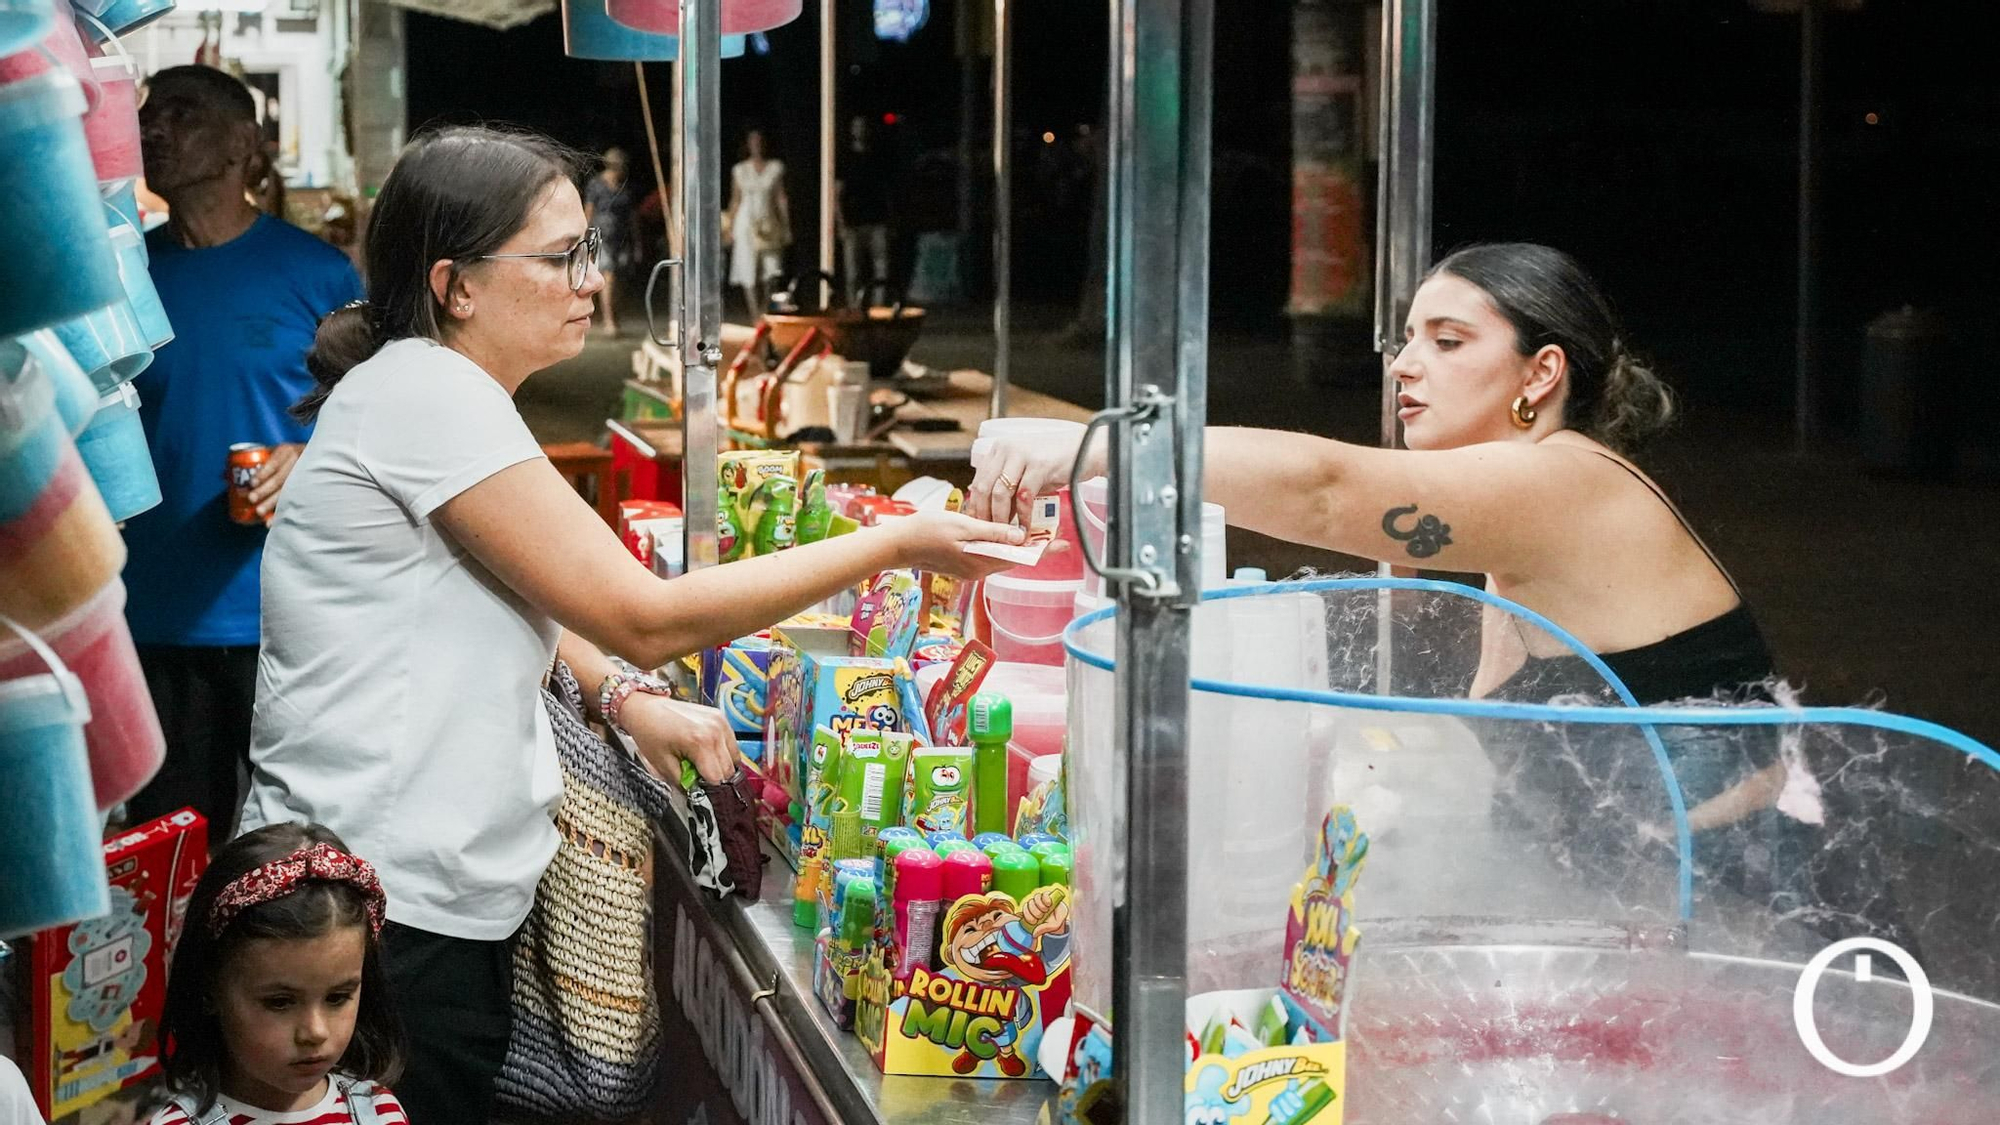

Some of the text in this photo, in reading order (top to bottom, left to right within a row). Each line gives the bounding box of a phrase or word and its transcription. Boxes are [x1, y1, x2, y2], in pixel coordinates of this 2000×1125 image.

[850, 678, 884, 697] JOHNY
[909, 967, 1016, 1018] ROLLIN
[902, 998, 1002, 1060] MIC
[1227, 1058, 1297, 1098] JOHNY
